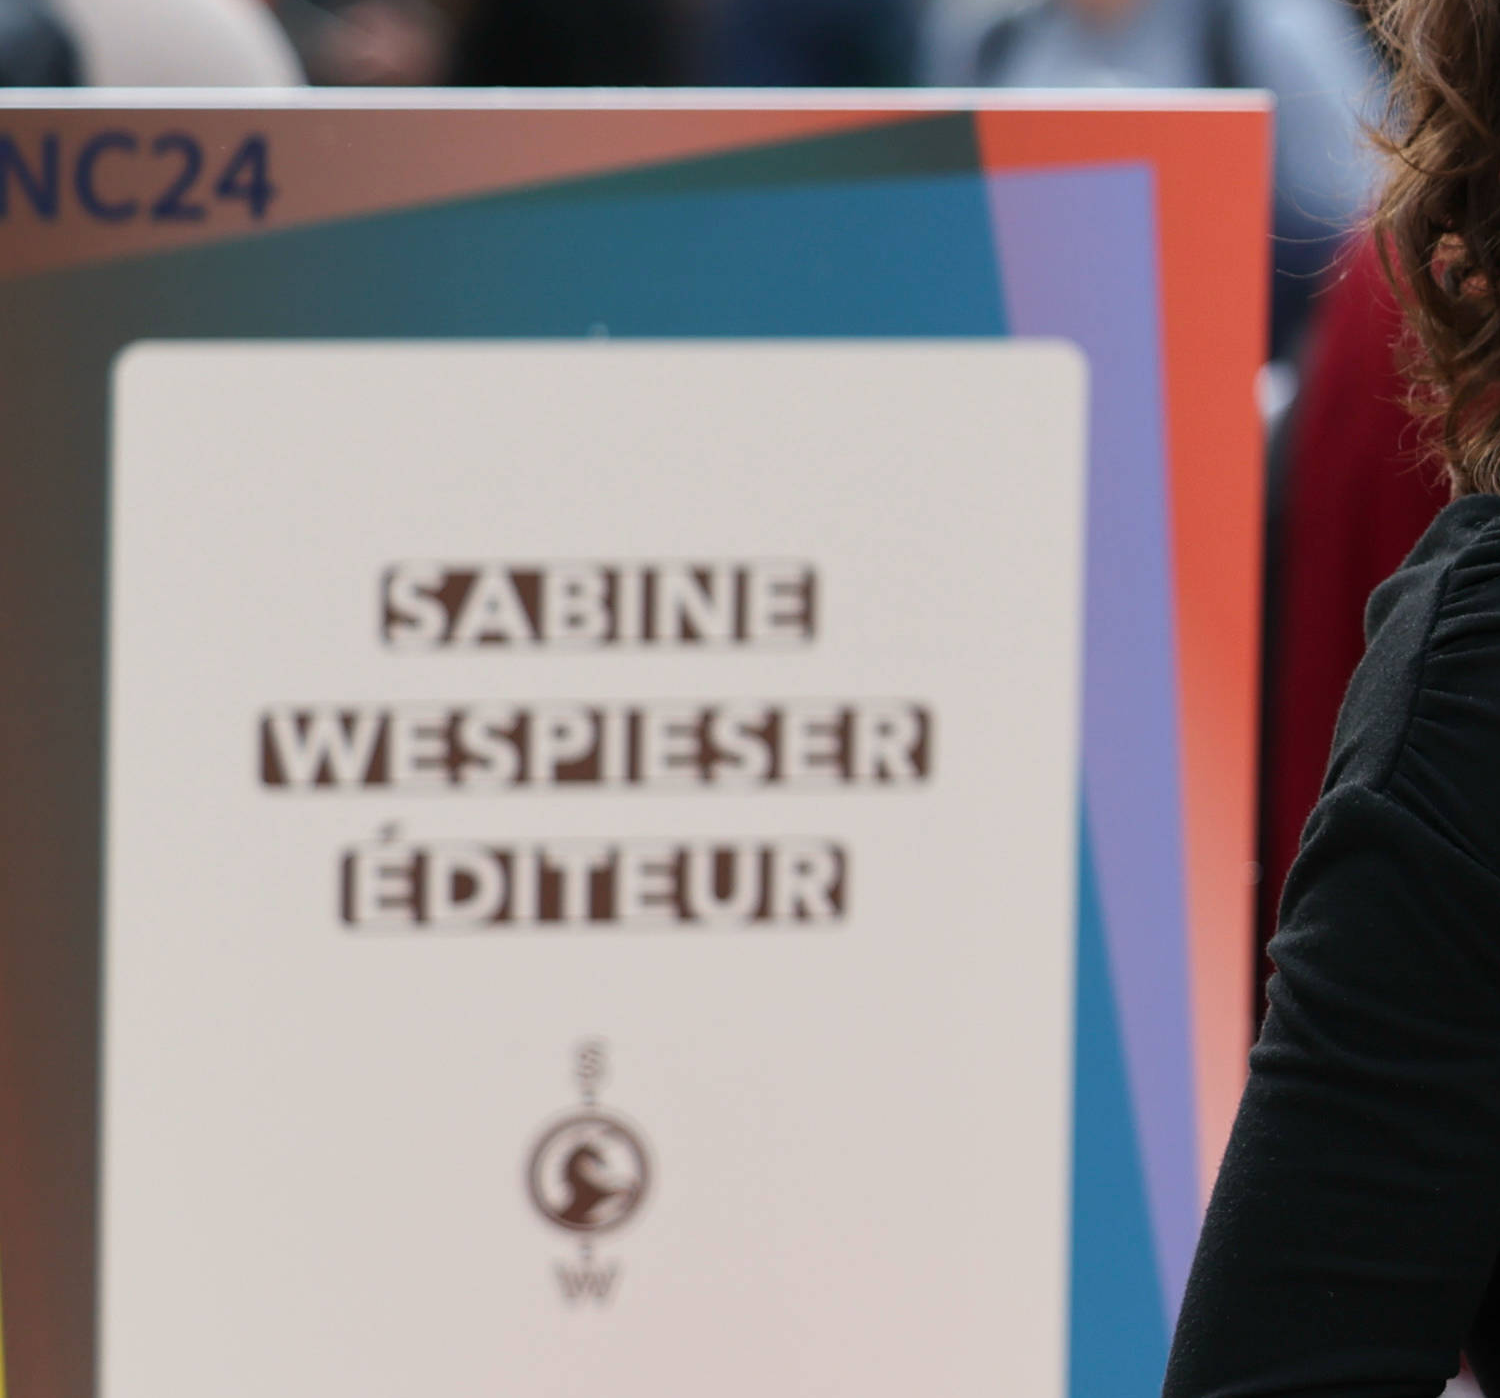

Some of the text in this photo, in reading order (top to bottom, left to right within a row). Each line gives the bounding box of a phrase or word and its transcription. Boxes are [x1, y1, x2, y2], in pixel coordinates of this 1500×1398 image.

[383, 565, 816, 647] SABINE
[258, 704, 932, 788] WESPIESER
[341, 825, 846, 927] ÉDITEUR
